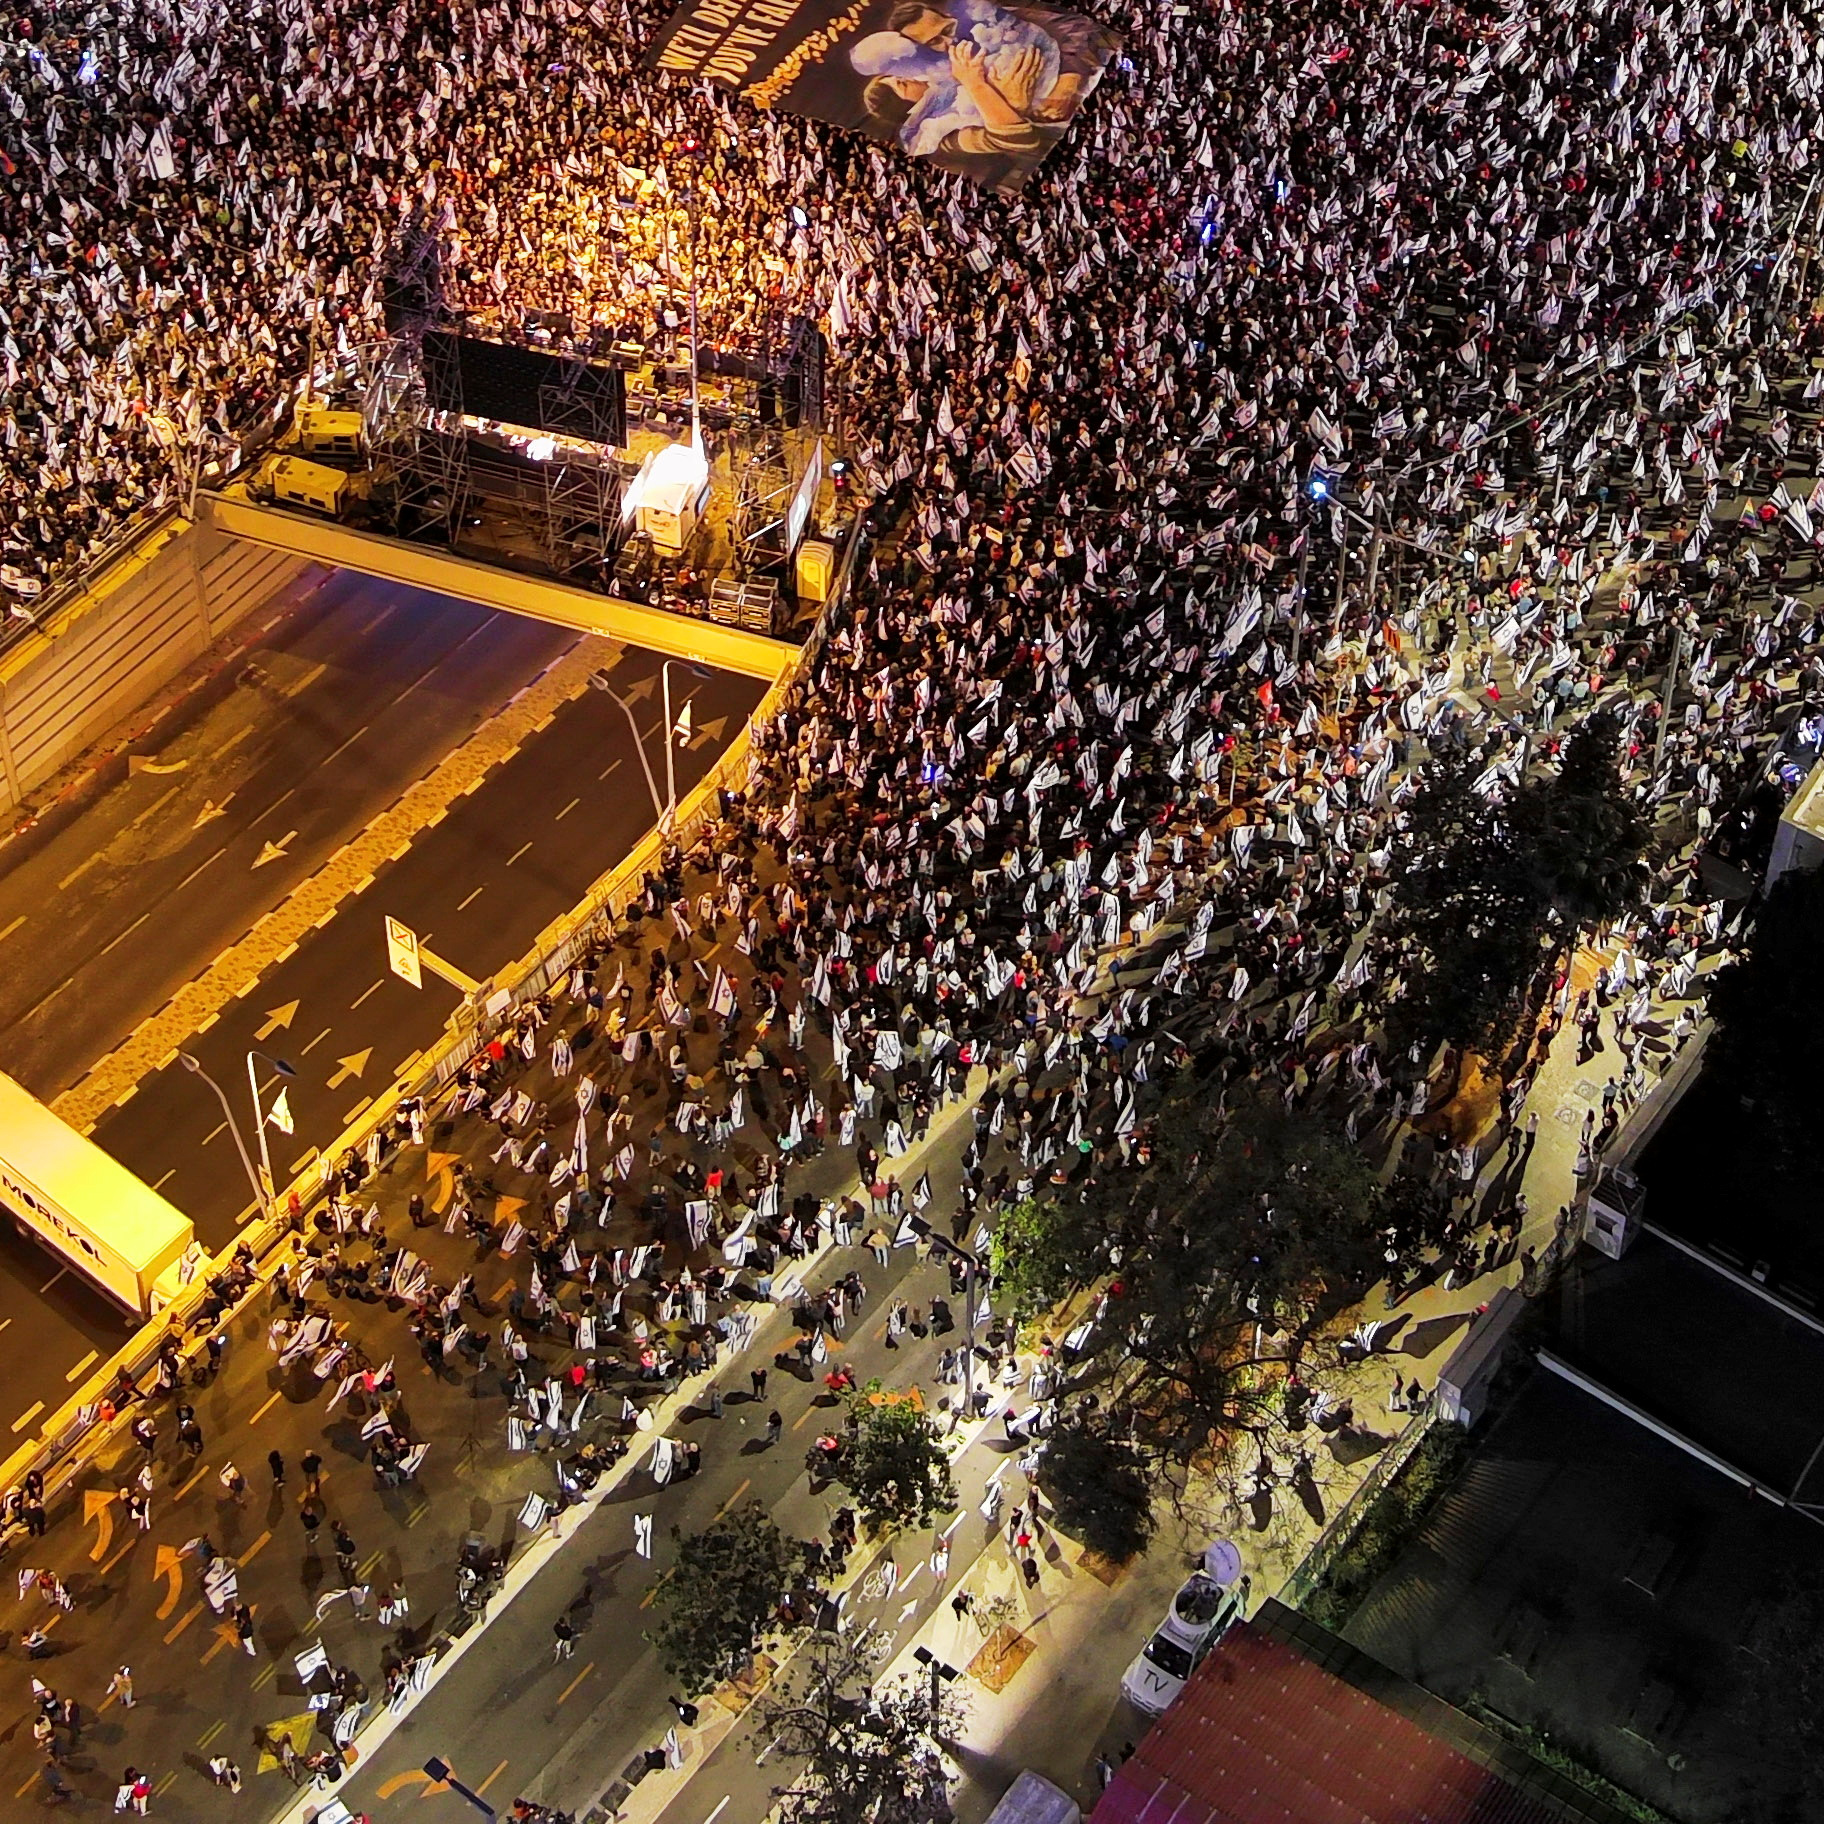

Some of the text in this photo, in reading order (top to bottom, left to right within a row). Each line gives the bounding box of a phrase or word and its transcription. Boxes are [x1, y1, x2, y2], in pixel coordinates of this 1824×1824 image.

[656, 24, 721, 70] WE'LL
[700, 24, 777, 85] YOU'VE
[2, 1174, 107, 1267] MOREKOL
[1146, 1668, 1169, 1692] TV
